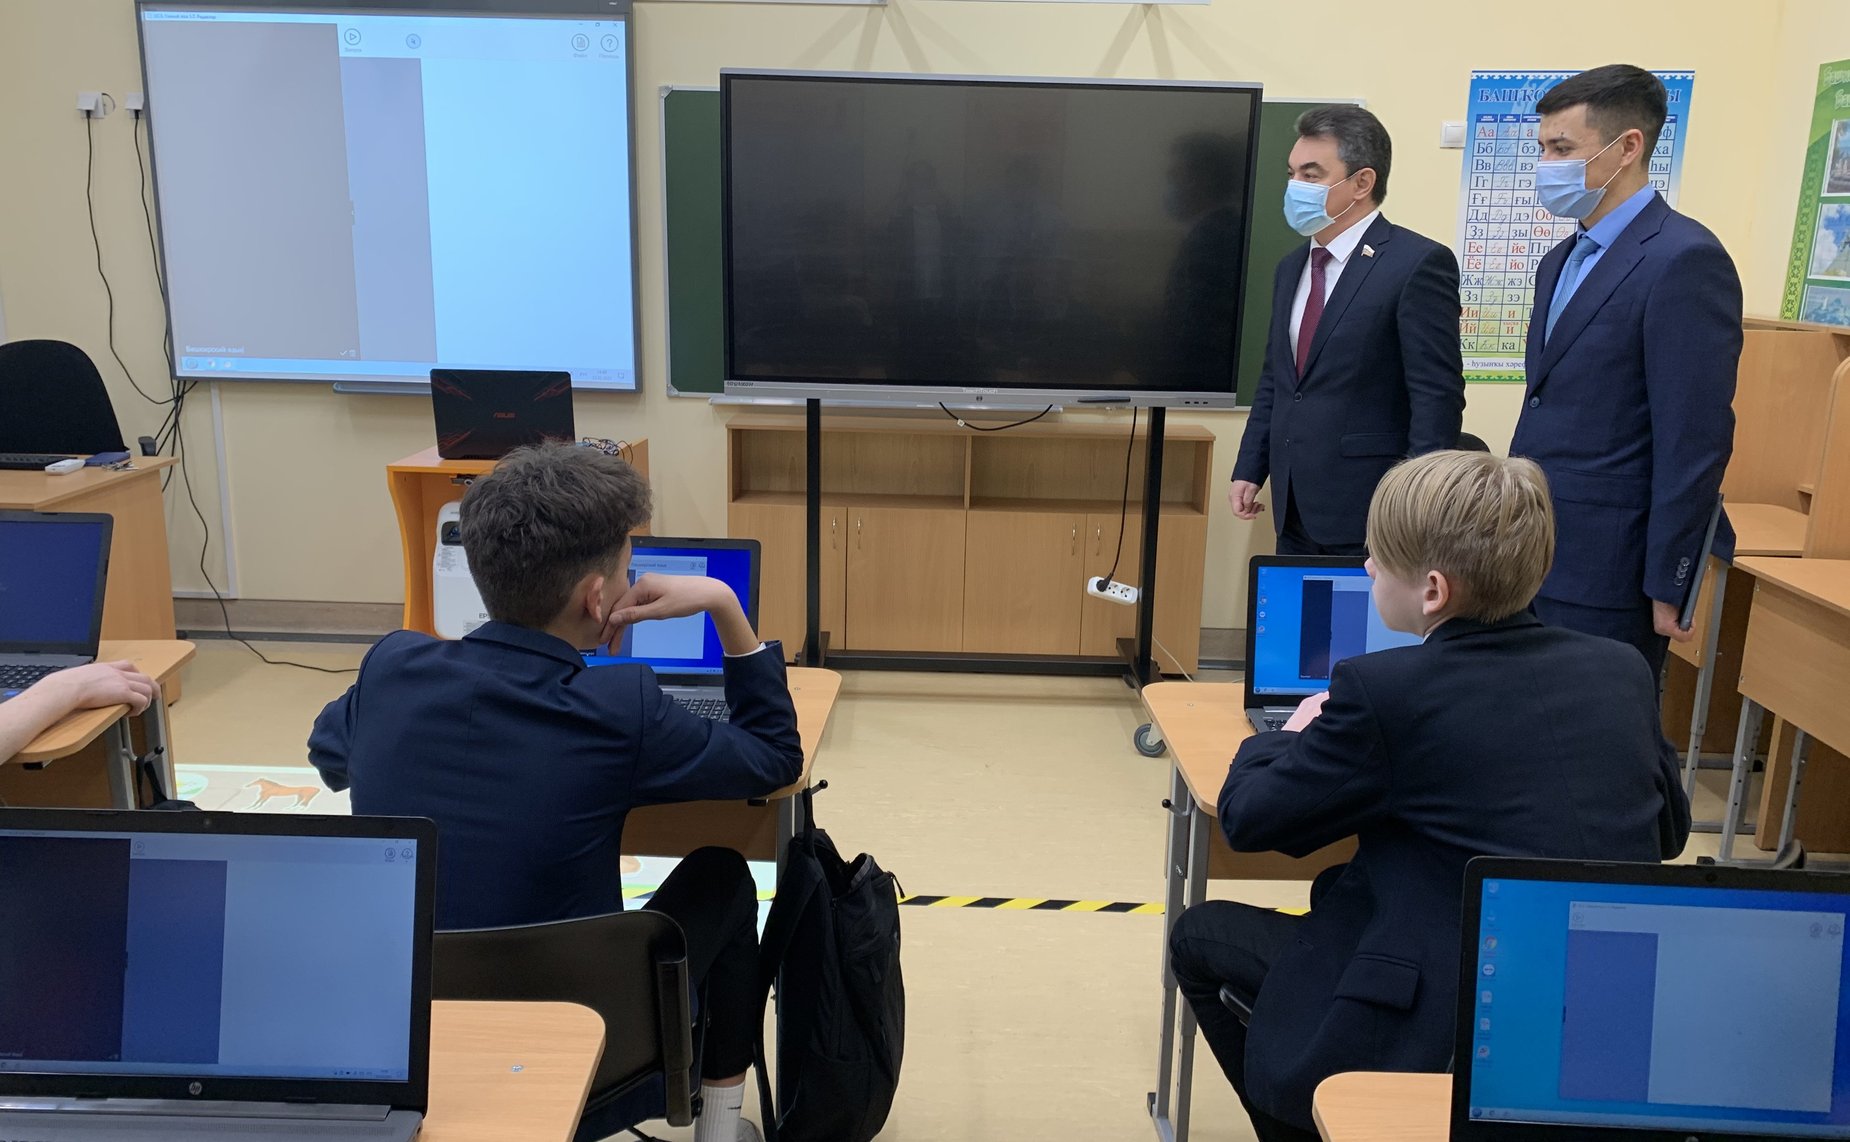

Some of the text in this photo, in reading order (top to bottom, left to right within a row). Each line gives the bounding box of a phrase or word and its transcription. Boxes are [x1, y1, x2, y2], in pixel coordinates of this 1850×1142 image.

[1476, 142, 1493, 154] Бб
[1521, 142, 1536, 154] бэ
[1475, 158, 1492, 171] Вв
[1520, 162, 1534, 171] вэ
[1474, 175, 1489, 188] Гг
[1468, 209, 1488, 221] Дд
[1468, 241, 1483, 253] Ее
[1462, 274, 1483, 286] Жж
[1464, 290, 1478, 302] Зз
